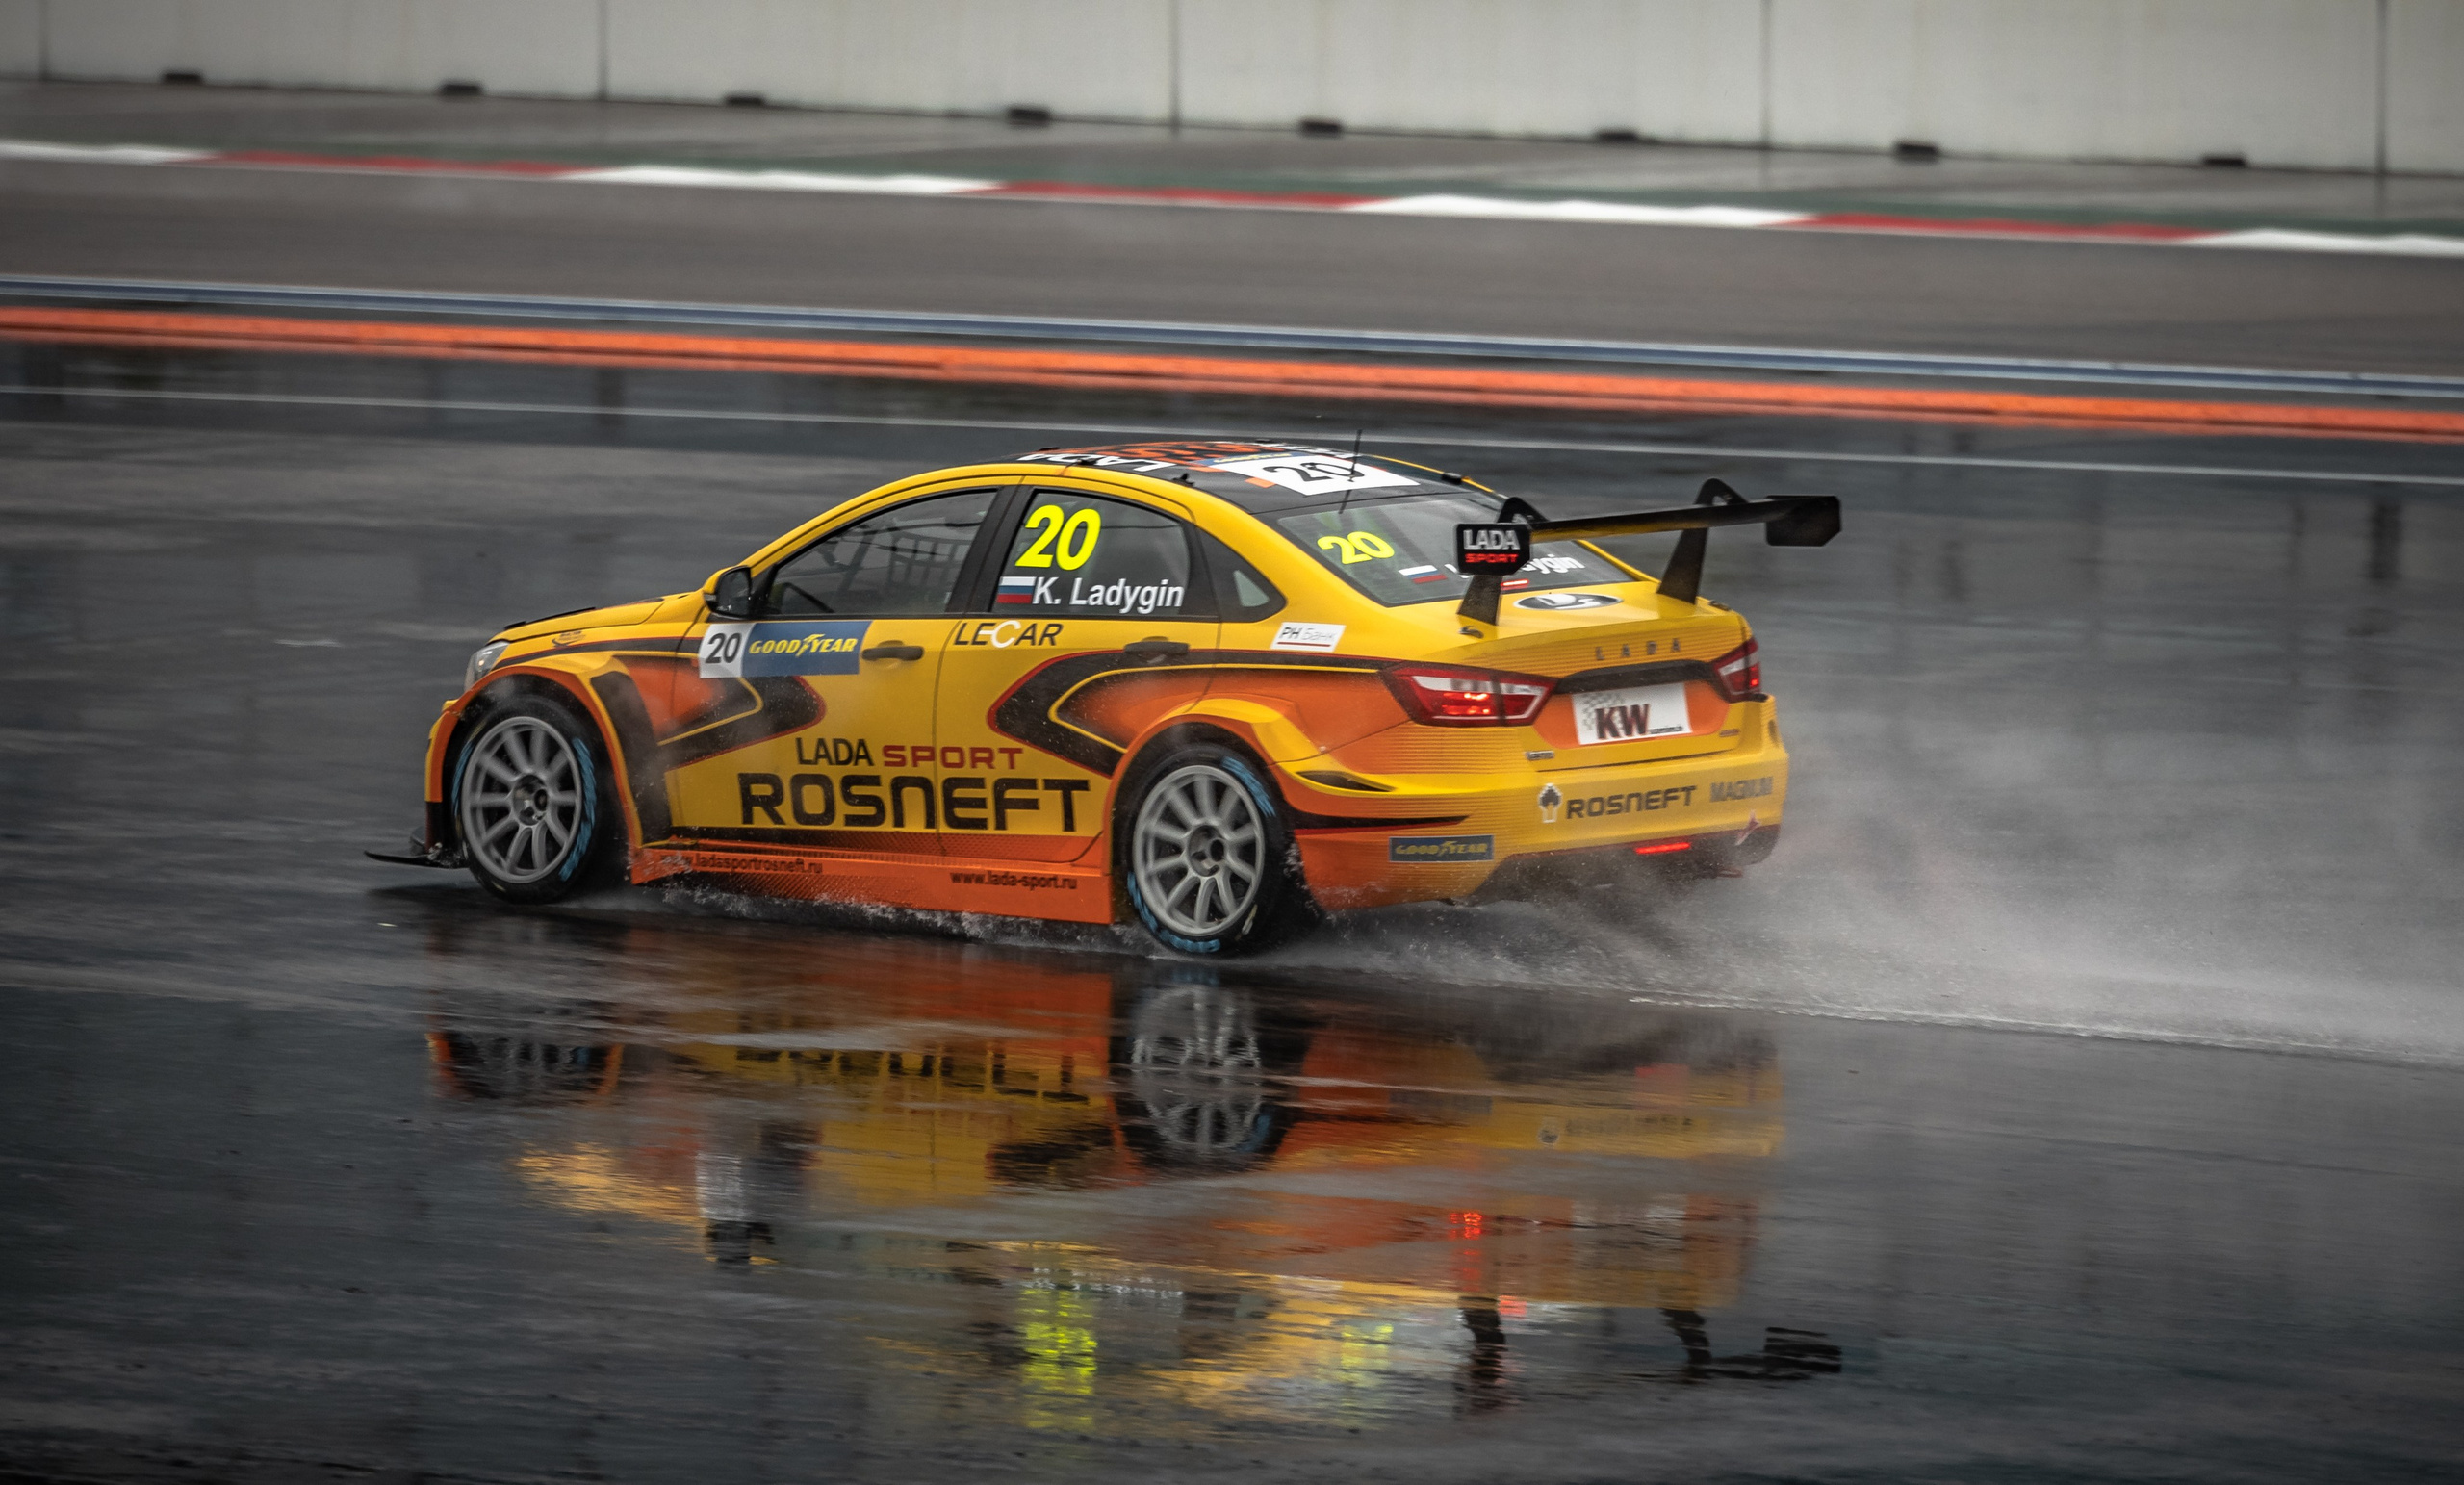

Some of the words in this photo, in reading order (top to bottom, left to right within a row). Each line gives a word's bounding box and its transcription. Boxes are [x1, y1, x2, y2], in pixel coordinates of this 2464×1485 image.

[1262, 462, 1365, 482] 20
[1014, 504, 1101, 571] 20
[1317, 531, 1395, 565] 20
[1463, 529, 1520, 550] LADA
[1465, 553, 1519, 564] SPORT
[1032, 577, 1061, 604] K.
[1069, 577, 1185, 614] Ladygin
[705, 632, 742, 664] 20
[749, 633, 859, 658] GOODYEAR
[953, 620, 1064, 648] LECAR
[1594, 637, 1681, 661] LADA
[1594, 704, 1650, 740] KW
[795, 737, 874, 767] LADA
[883, 744, 1023, 770] SPORT
[737, 773, 1091, 832] ROSNEFT
[1566, 785, 1697, 819] ROSNEFT
[949, 870, 1078, 891] www.lada-sport.ru
